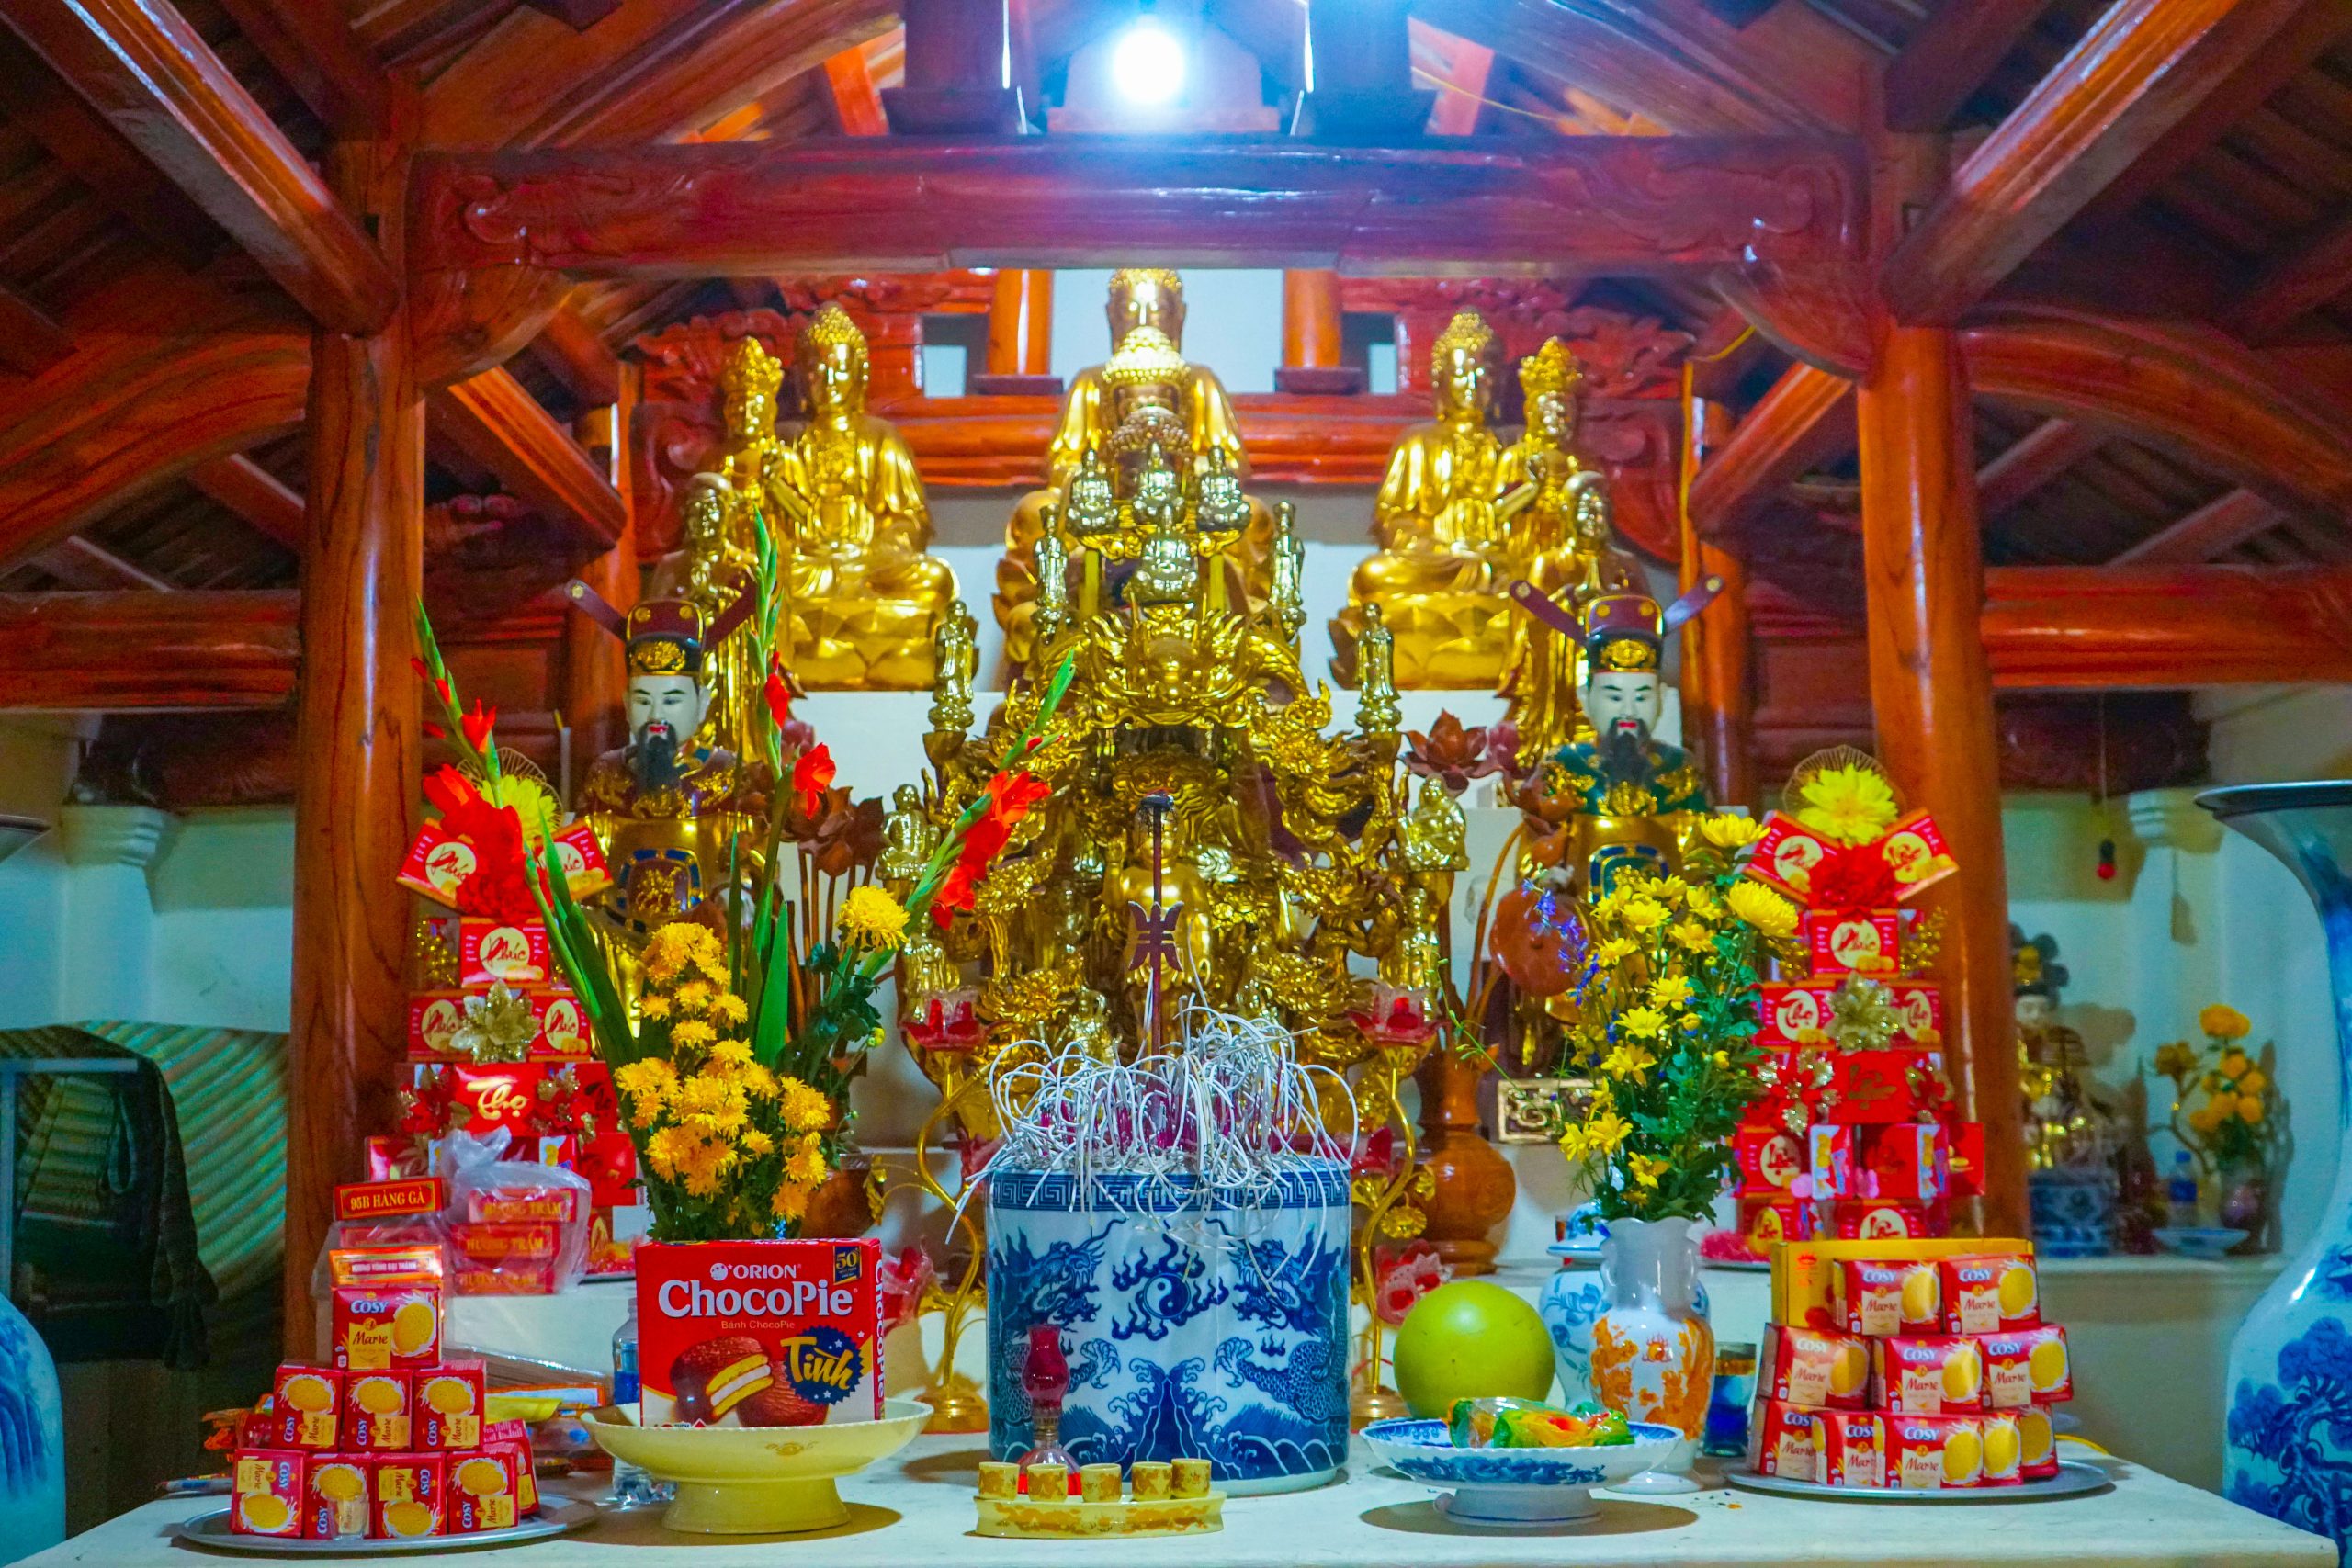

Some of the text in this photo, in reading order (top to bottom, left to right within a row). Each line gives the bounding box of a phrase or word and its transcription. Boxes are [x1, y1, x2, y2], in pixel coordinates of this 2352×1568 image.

[733, 1263, 797, 1280] ORION
[1862, 1269, 1897, 1283] COSY
[1959, 1269, 1992, 1283] COSY
[658, 1279, 854, 1318] ChocoPie
[350, 1300, 390, 1314] COSY
[721, 1319, 796, 1330] Bánh ChocoPie
[353, 1330, 389, 1346] Marie
[1795, 1338, 1828, 1353] COSY
[1903, 1348, 1938, 1361] COSY
[1988, 1340, 2023, 1356] COSY
[1783, 1412, 1811, 1426] COS
[284, 1415, 295, 1443] COSY
[356, 1418, 368, 1446] COSY
[427, 1418, 438, 1446] COSY
[1845, 1425, 1873, 1438] COS
[1904, 1427, 1940, 1440] COSY
[279, 1461, 290, 1490] COSY
[420, 1469, 431, 1496] COSY
[462, 1501, 473, 1529] COSY
